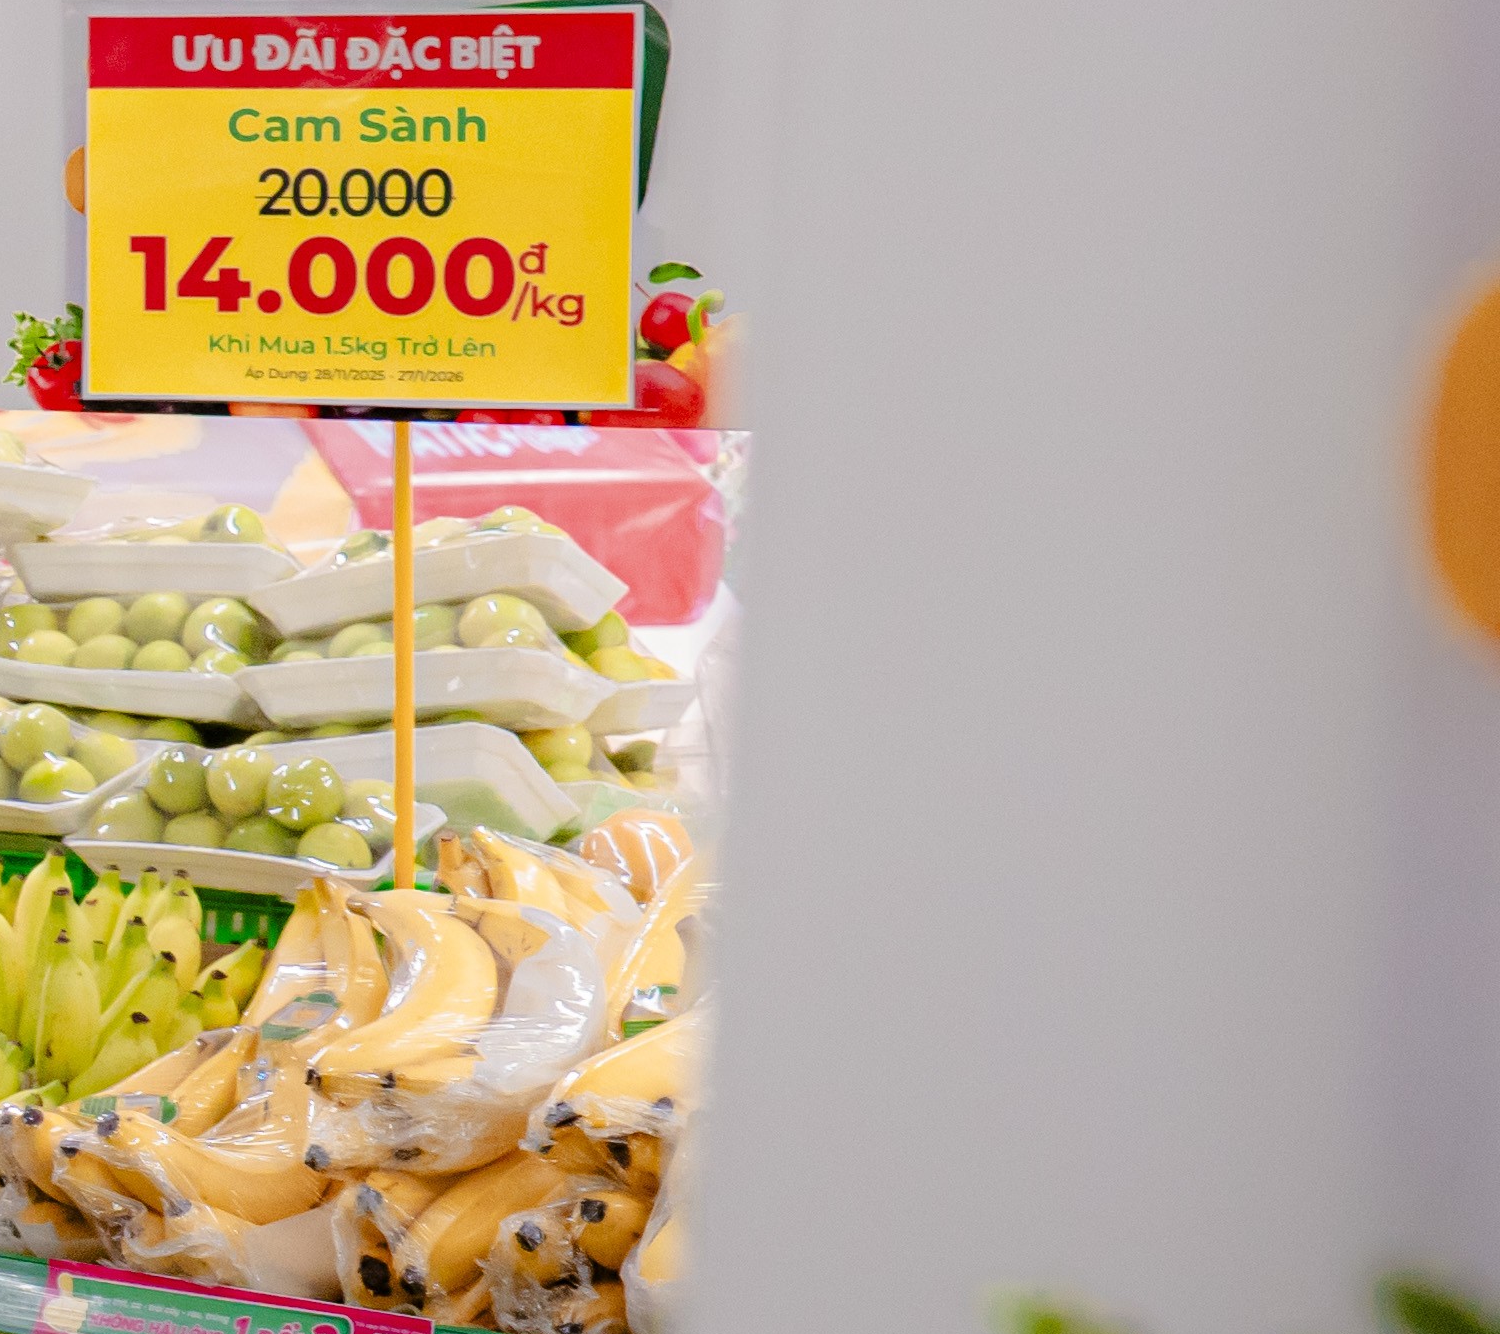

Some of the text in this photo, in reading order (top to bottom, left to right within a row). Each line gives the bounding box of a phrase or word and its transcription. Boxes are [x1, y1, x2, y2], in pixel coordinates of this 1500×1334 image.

[172, 23, 542, 82] ƯU ĐÃI ĐẶC BIỆT
[228, 106, 488, 145] Cam Sành
[256, 167, 455, 218] 20.000
[130, 234, 515, 318] 14.000
[208, 334, 496, 361] Khi Mua 1.5kg Trở Lên
